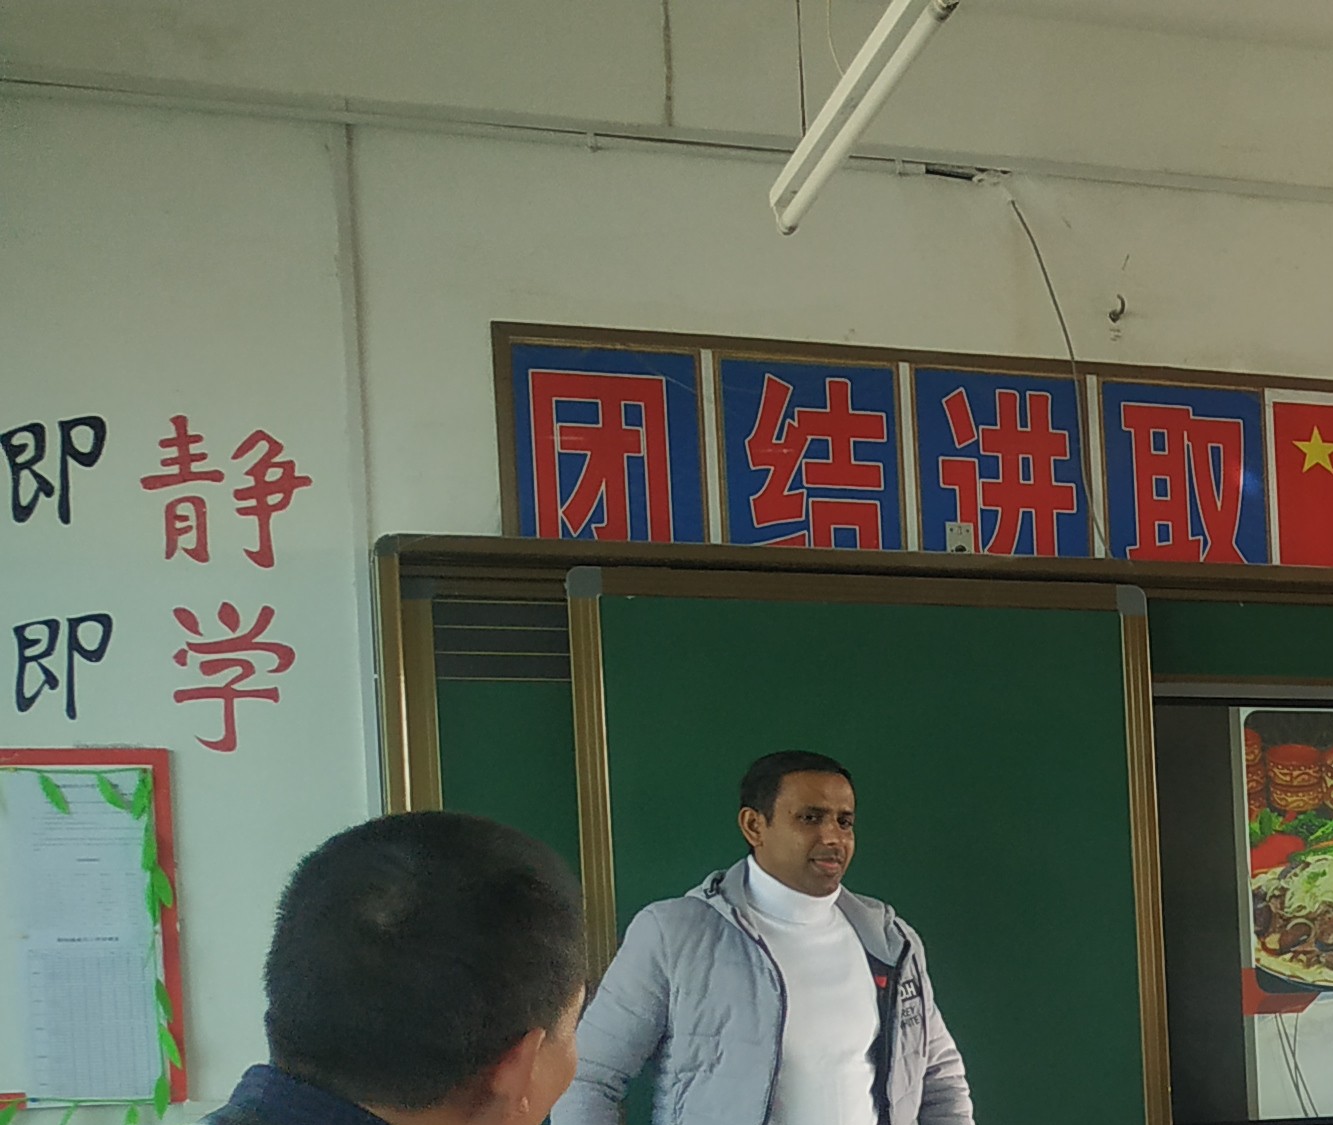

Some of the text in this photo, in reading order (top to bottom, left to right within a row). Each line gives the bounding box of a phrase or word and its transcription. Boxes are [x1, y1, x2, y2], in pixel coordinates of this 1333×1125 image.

[0, 414, 313, 570] 即静
[526, 367, 1250, 563] 团结进取
[13, 602, 297, 753] 即学
